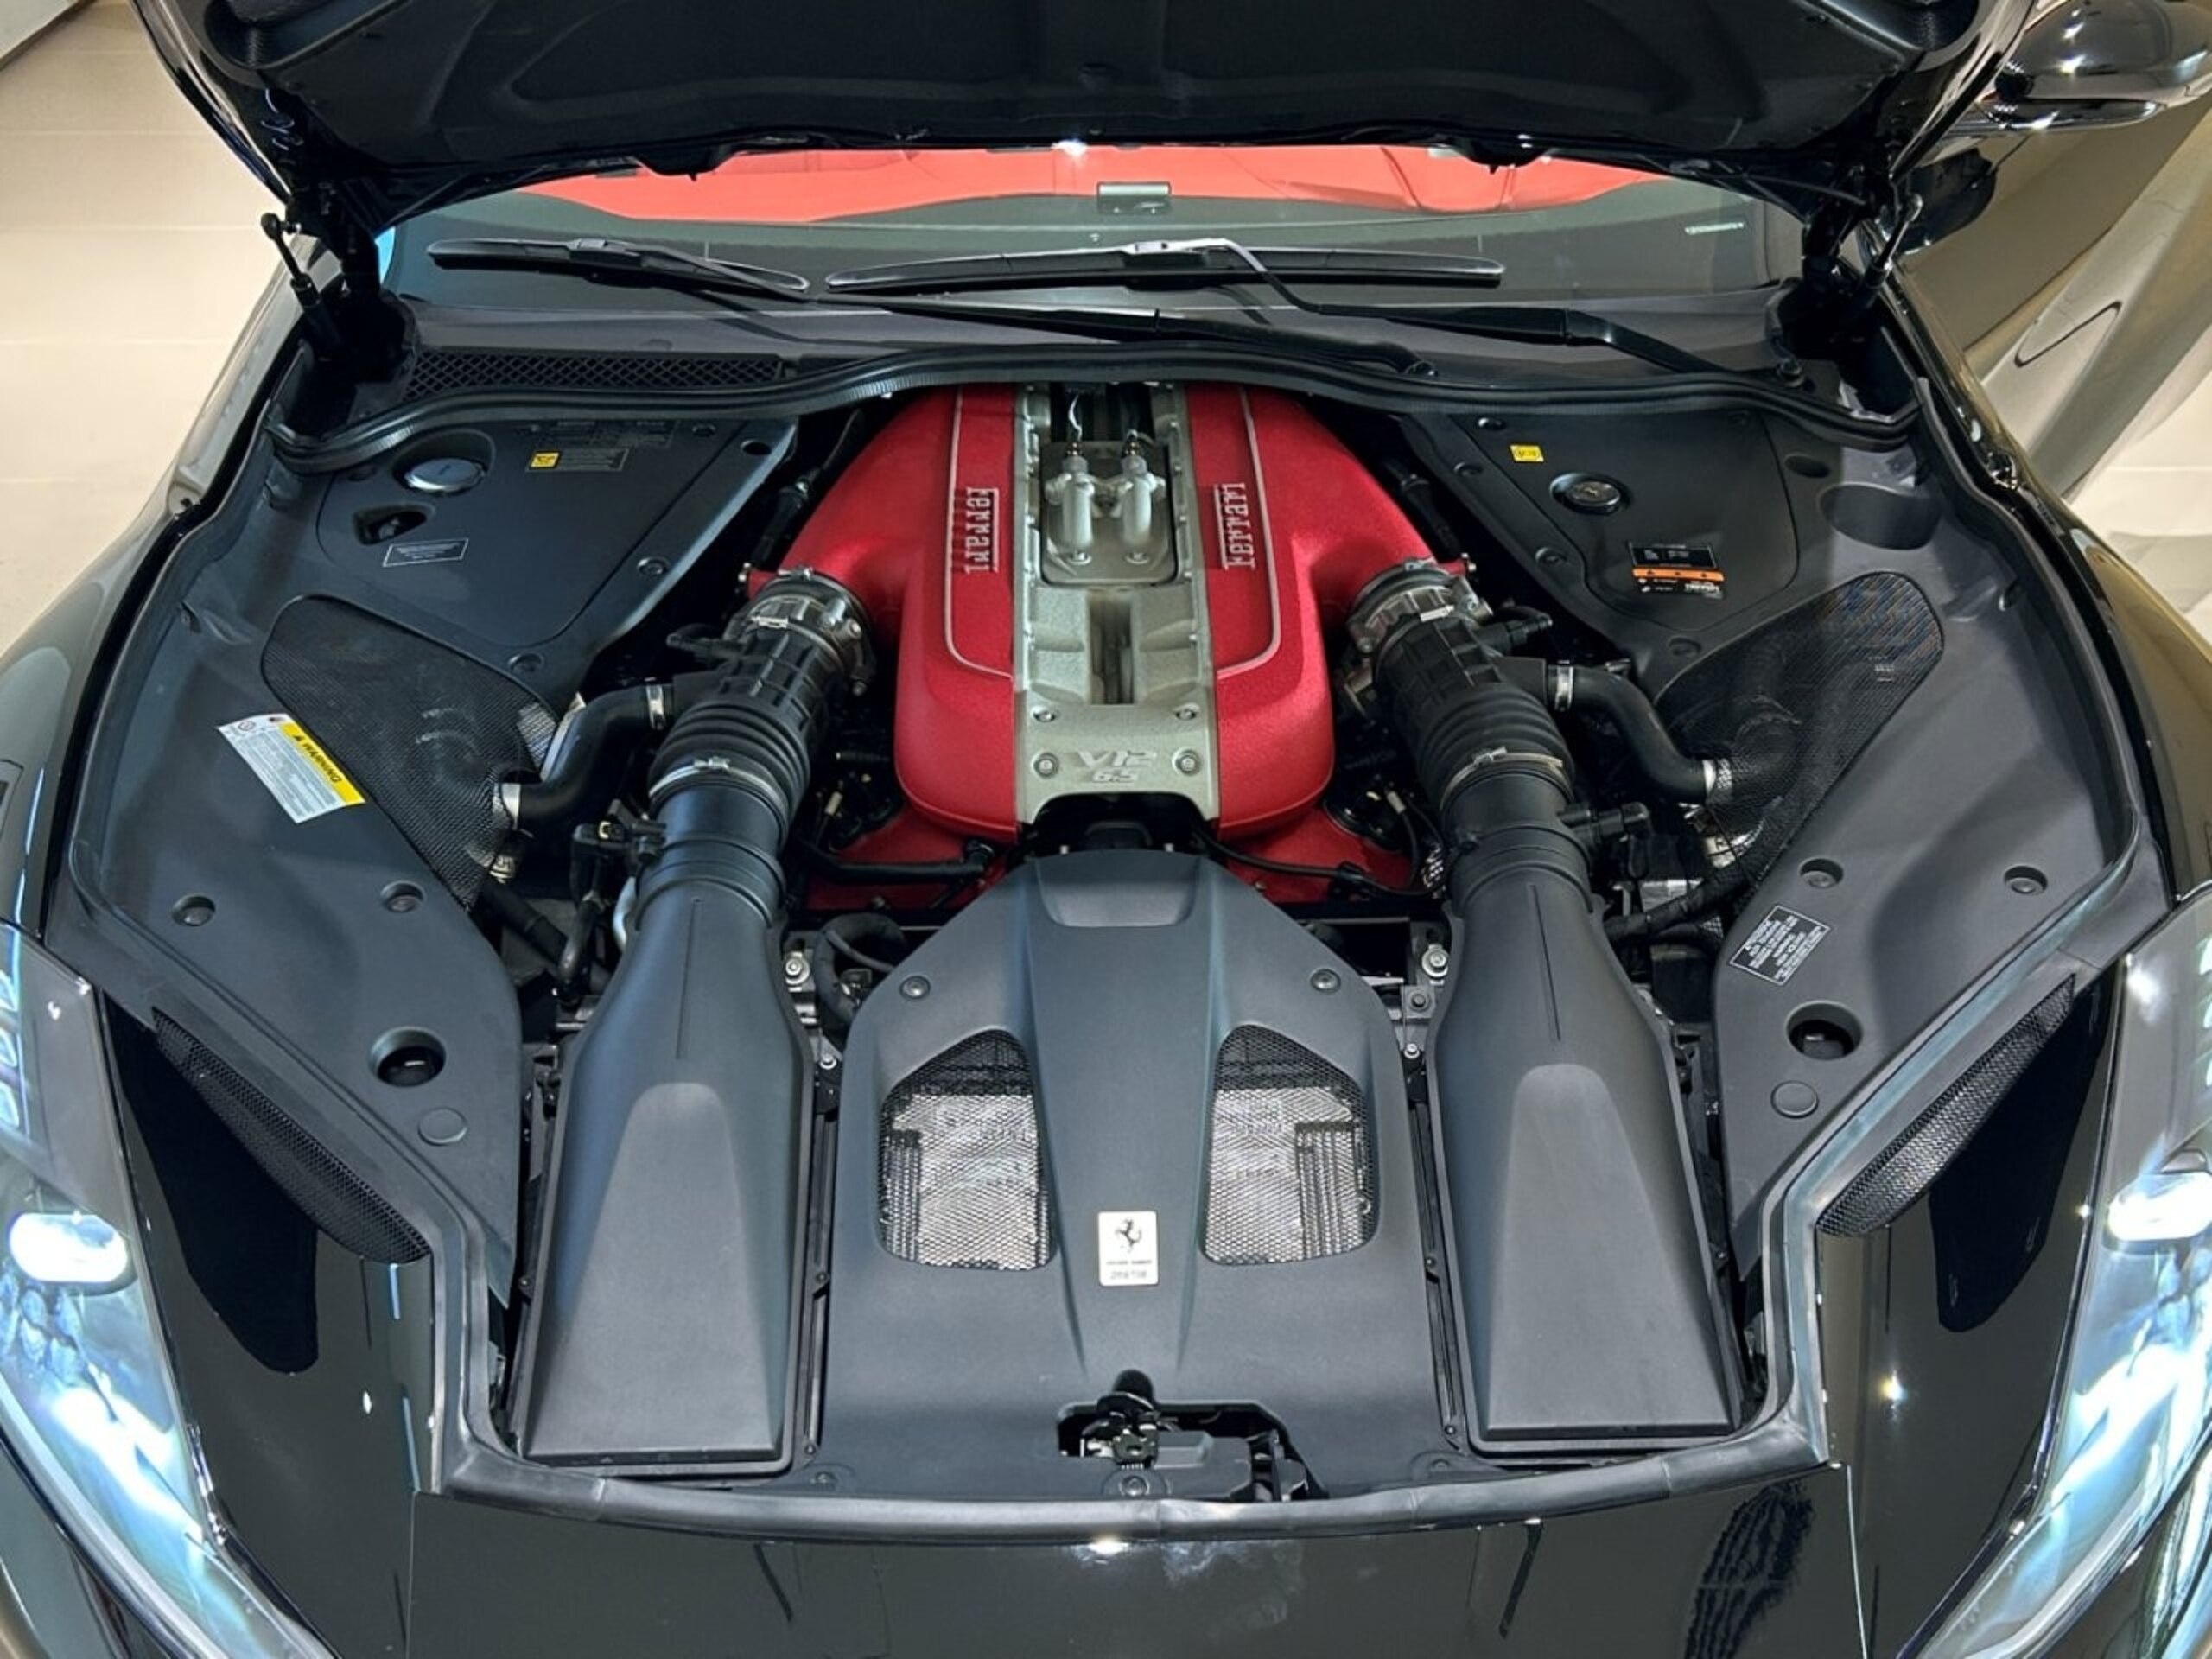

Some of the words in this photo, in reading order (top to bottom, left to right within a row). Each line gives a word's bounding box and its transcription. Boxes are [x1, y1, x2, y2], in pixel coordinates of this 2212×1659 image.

[964, 487, 999, 574] Ferrari
[1214, 483, 1255, 569] Ferrari
[302, 741, 342, 783] WARNING
